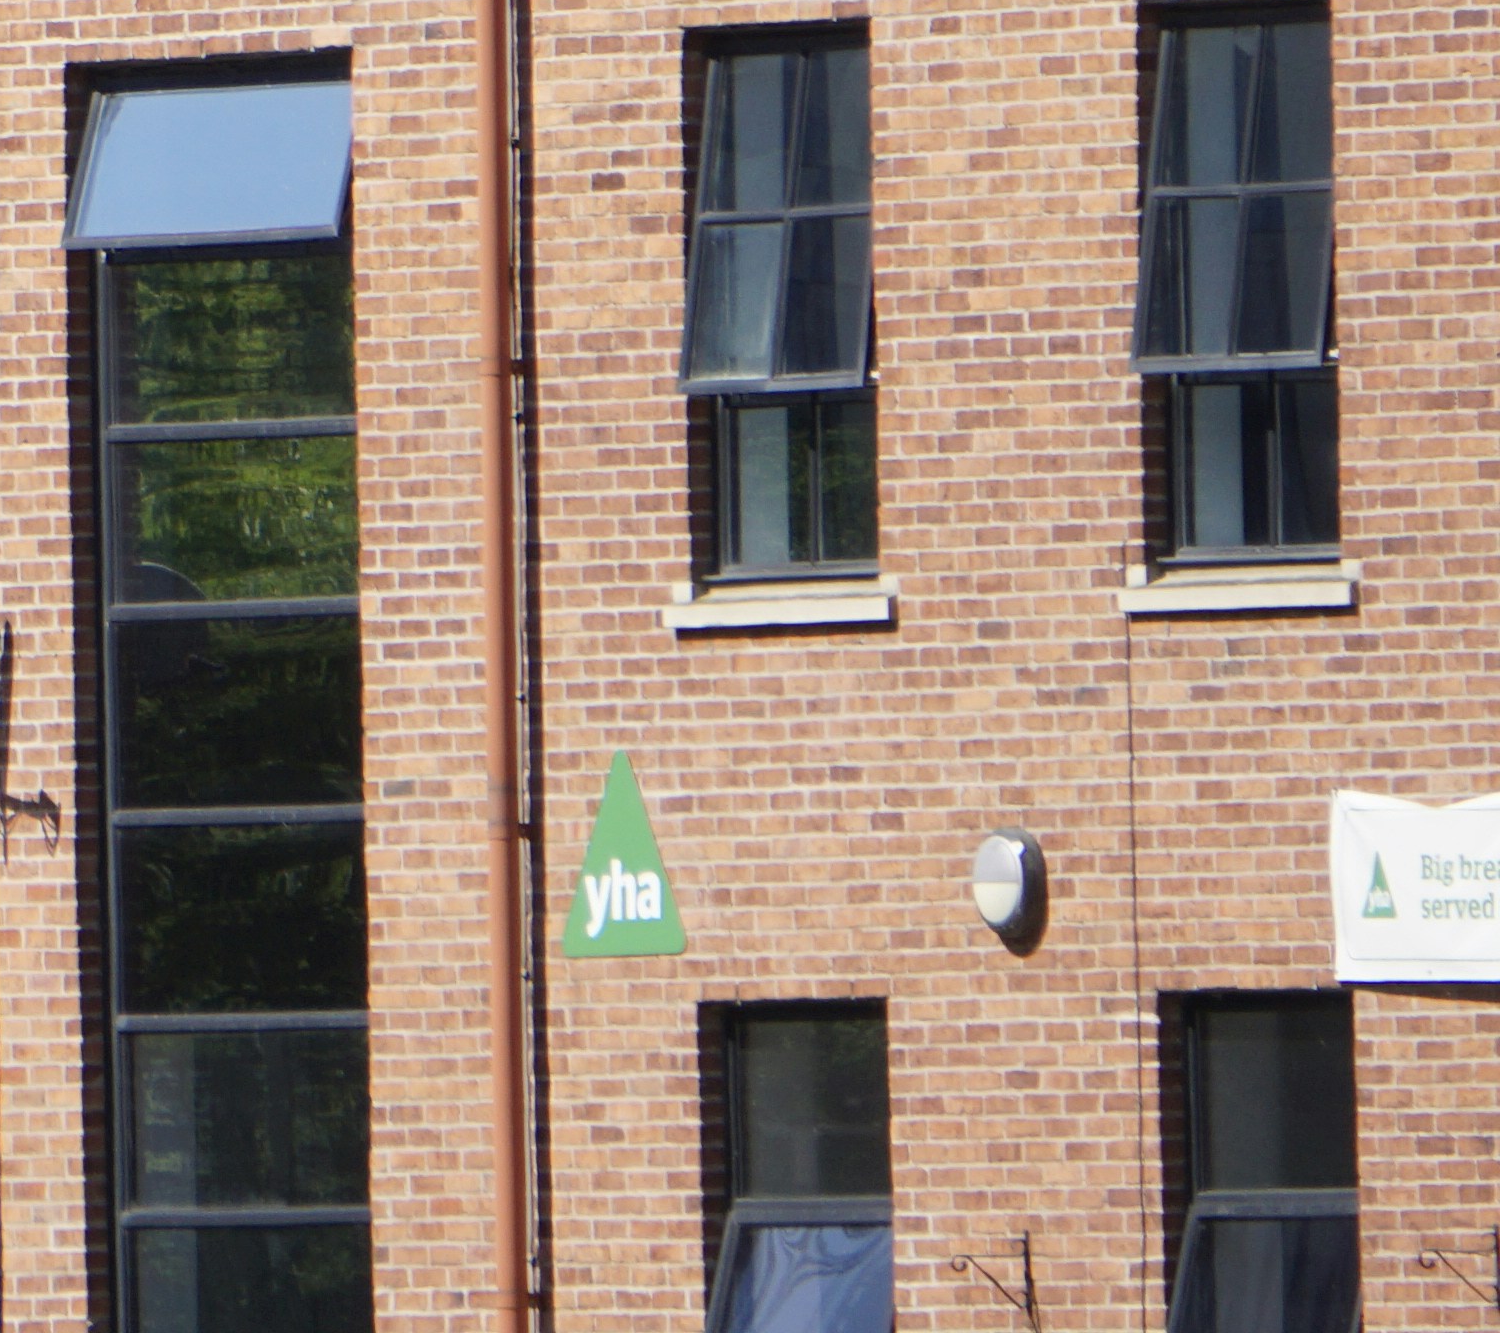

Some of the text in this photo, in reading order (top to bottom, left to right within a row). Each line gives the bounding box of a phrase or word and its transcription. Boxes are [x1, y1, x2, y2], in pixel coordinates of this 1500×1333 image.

[1421, 854, 1500, 886] Big bre
[584, 858, 662, 939] yha
[1421, 892, 1494, 919] served
